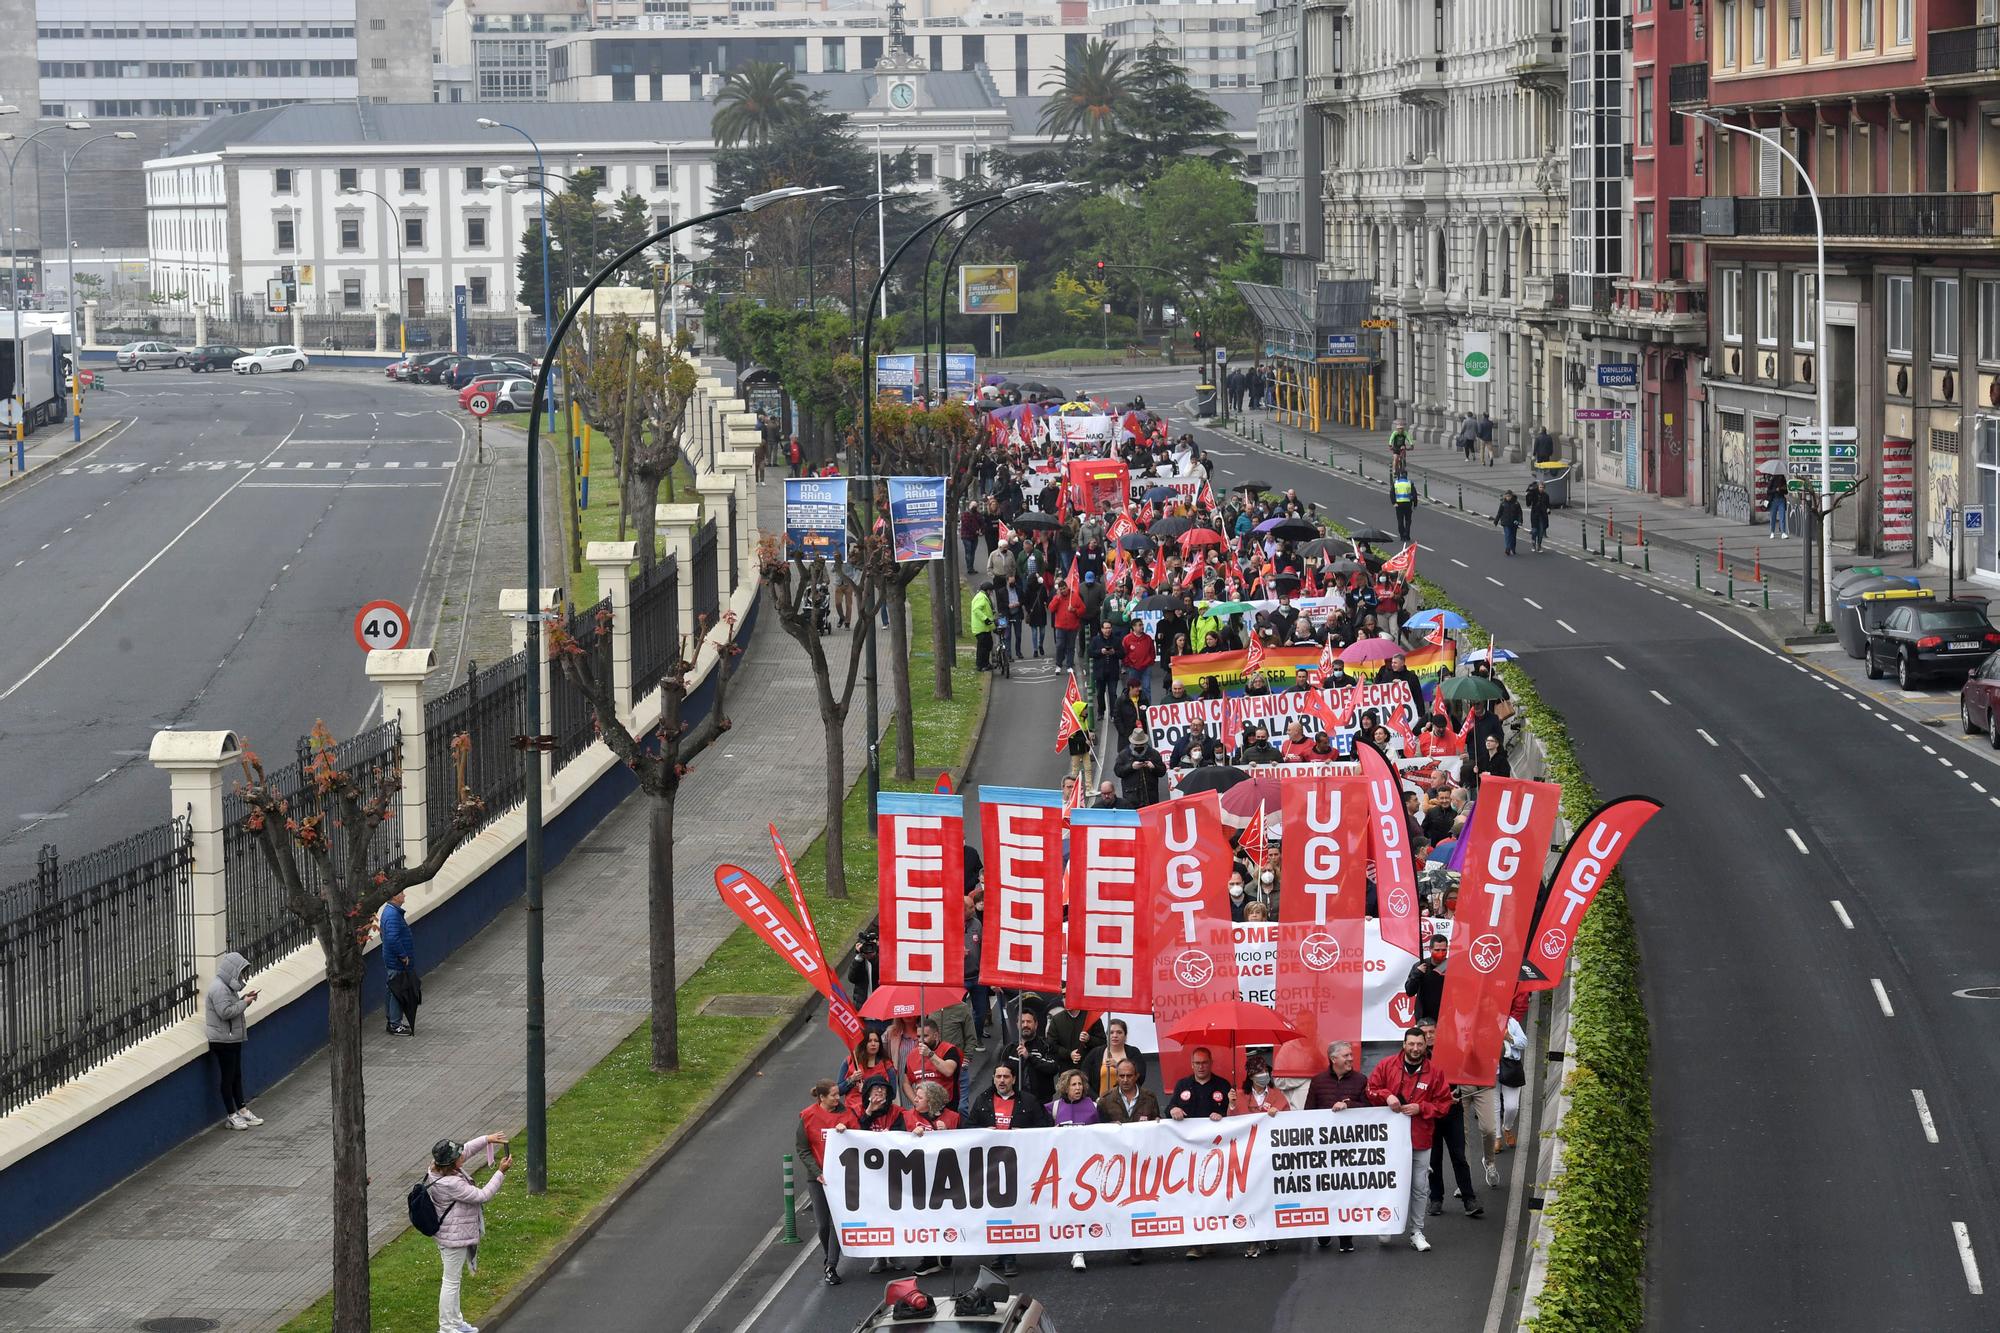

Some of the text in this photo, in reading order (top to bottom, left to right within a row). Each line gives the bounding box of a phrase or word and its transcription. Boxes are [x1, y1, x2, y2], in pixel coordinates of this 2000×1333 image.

[1602, 374, 1632, 384] TERRÓN
[472, 399, 488, 409] 40
[364, 620, 398, 638] 40
[1266, 669, 1286, 683] SER
[1149, 703, 1182, 728] POR
[1184, 700, 1207, 721] UN
[1304, 790, 1341, 926] UGT
[1484, 790, 1534, 927] UGT
[1165, 808, 1205, 943] UGT
[1560, 821, 1622, 925] UGT
[895, 815, 945, 984] CCOO
[998, 804, 1045, 975] CCOO
[1084, 827, 1136, 998] CCOO
[1270, 1123, 1389, 1148] SUBIR SALARIOS
[1030, 1124, 1258, 1212] A SOLUCIÓN
[1271, 1147, 1386, 1171] CONTER PREZOS
[1273, 1170, 1397, 1194] MÁIS IGUALDADE
[1134, 1215, 1229, 1234] CCOO UGT
[1278, 1207, 1374, 1225] CCOO UGT
[844, 1228, 940, 1244] CCOO UGT
[990, 1224, 1085, 1241] CCOO UGT
